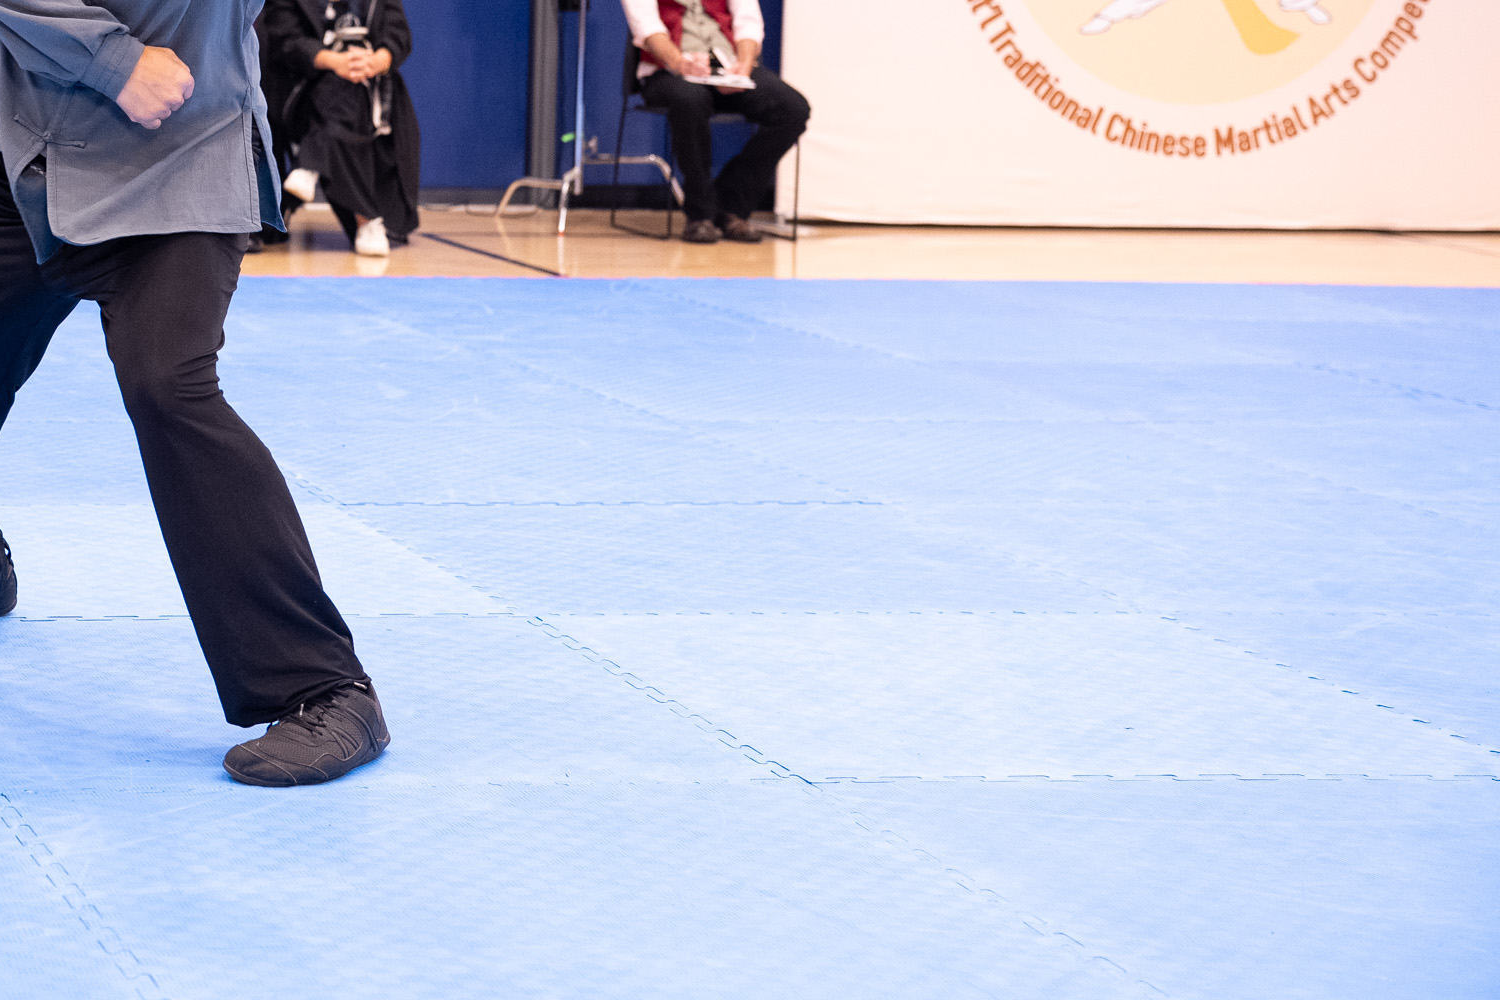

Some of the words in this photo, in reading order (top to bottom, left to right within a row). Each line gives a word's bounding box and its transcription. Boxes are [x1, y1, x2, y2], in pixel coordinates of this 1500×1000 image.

[989, 21, 1105, 135] Traditional
[1105, 113, 1206, 157] Chinese
[1214, 105, 1308, 156] Martial
[1308, 78, 1361, 125] Arts
